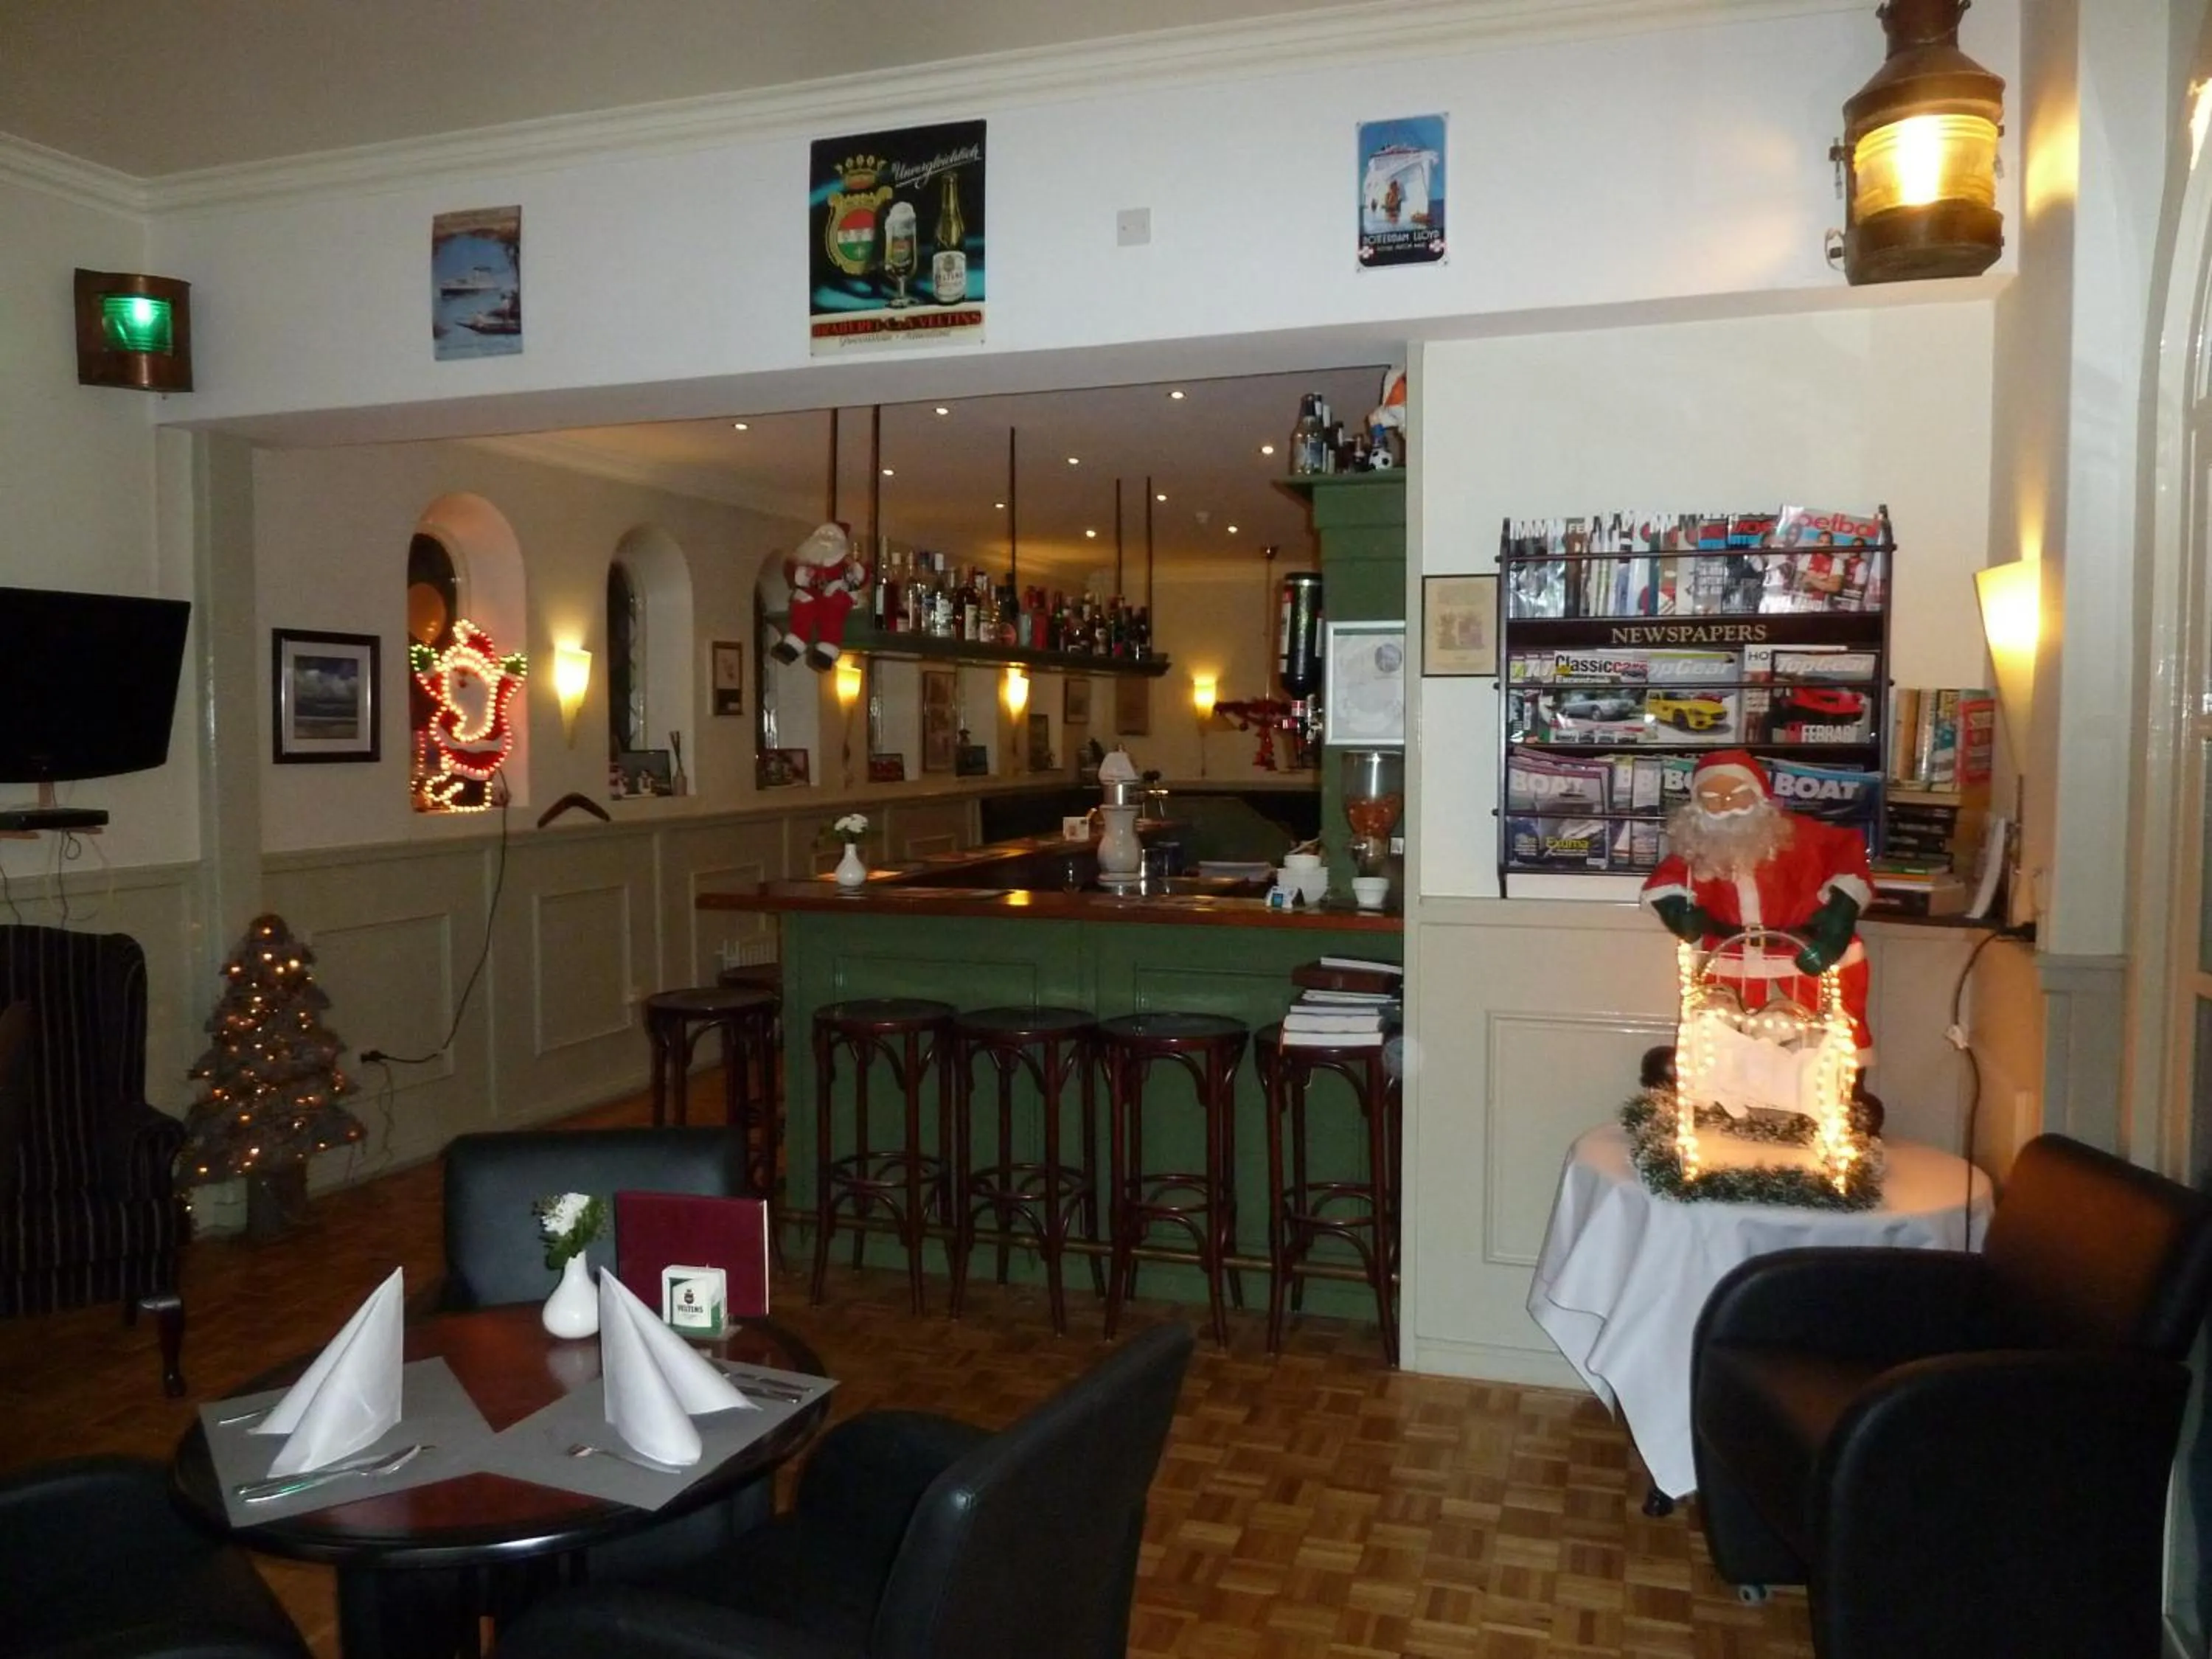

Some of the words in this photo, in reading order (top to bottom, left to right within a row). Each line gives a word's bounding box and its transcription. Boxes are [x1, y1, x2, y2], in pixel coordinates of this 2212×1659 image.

[1611, 624, 1767, 644] NEWSPAPERS
[1511, 771, 1585, 795] BOAT
[1773, 772, 1861, 800] BOAT
